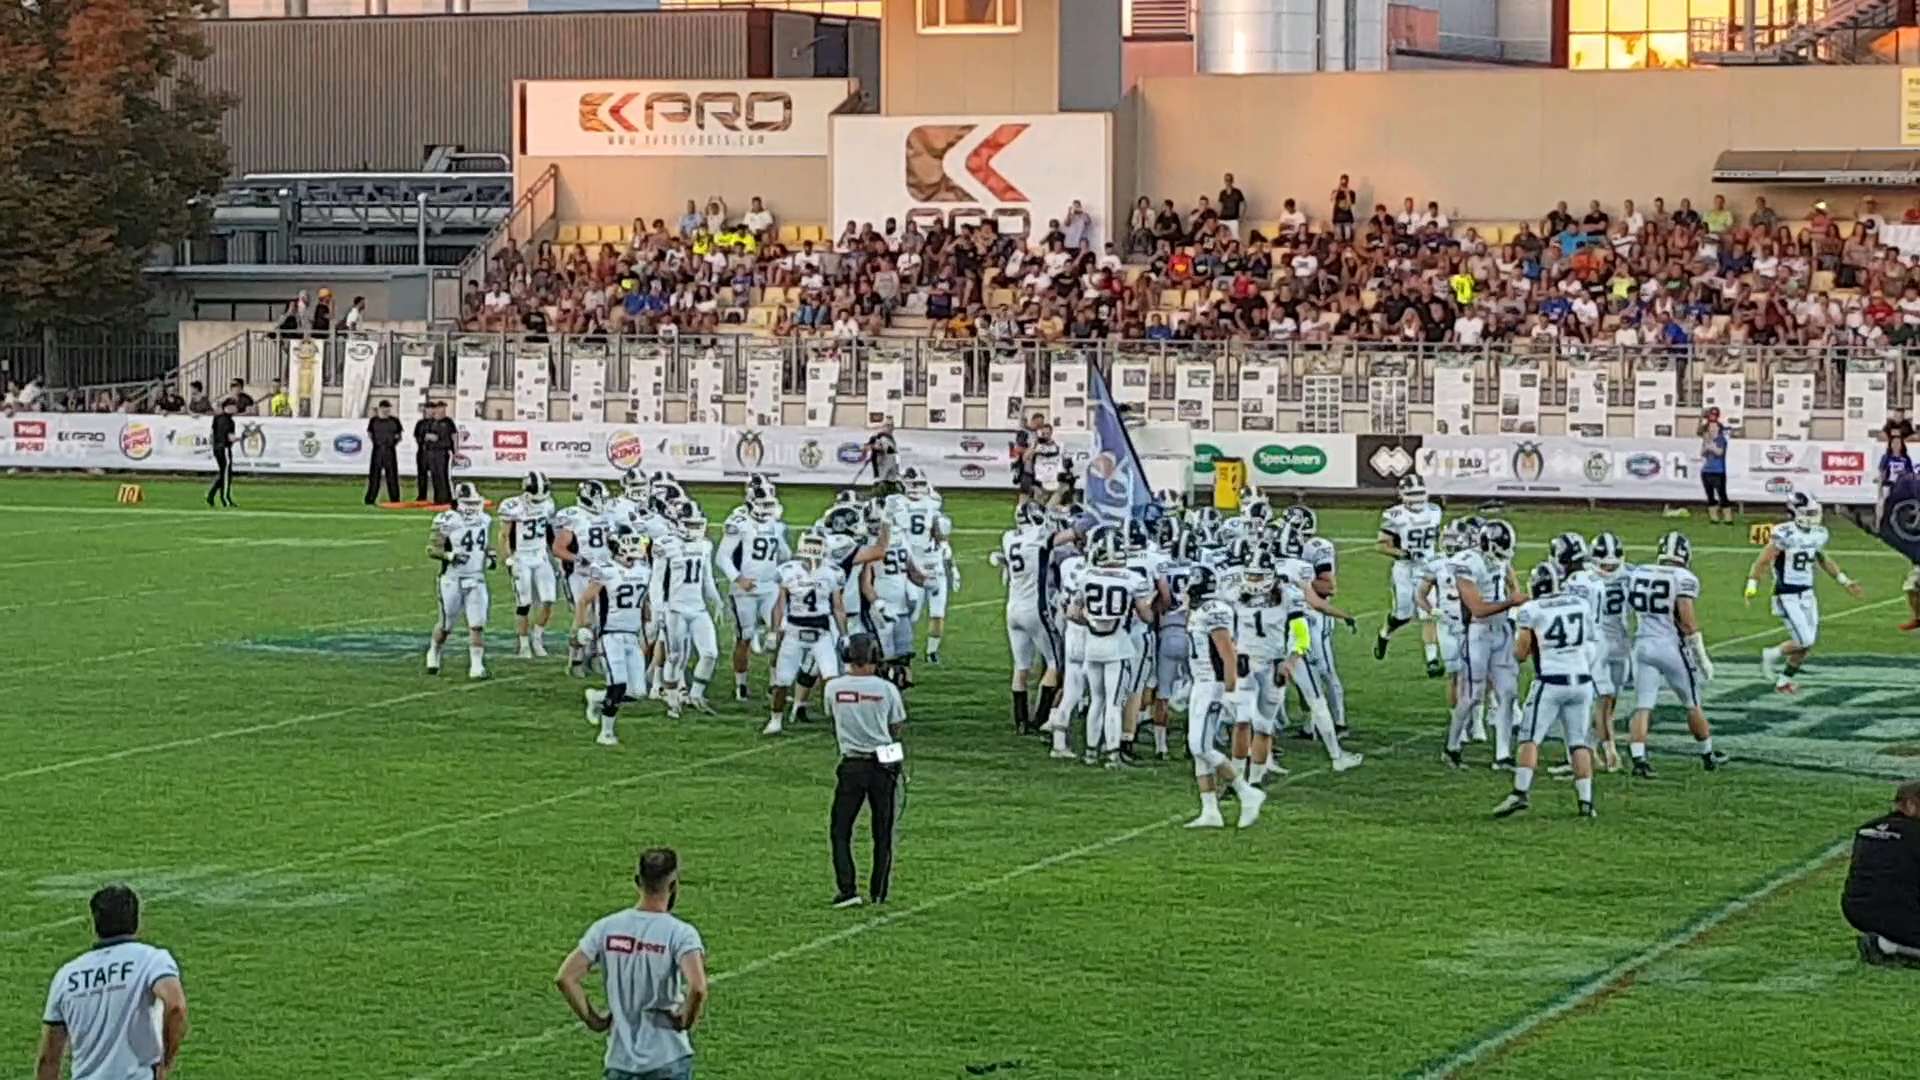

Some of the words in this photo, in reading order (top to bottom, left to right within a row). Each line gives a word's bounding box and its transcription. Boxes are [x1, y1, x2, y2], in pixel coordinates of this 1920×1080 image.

[1259, 451, 1320, 466] Specsavers
[910, 515, 925, 536] 6
[1752, 526, 1771, 545] 40
[460, 528, 486, 552] 44
[752, 537, 779, 561] 97
[1009, 542, 1025, 572] 5
[616, 583, 649, 609] 27
[803, 588, 817, 612] 4
[1085, 582, 1128, 616] 20
[1629, 578, 1669, 614] 62
[1252, 610, 1266, 637] 1
[1544, 612, 1583, 649] 47
[68, 960, 134, 992] STAFF
